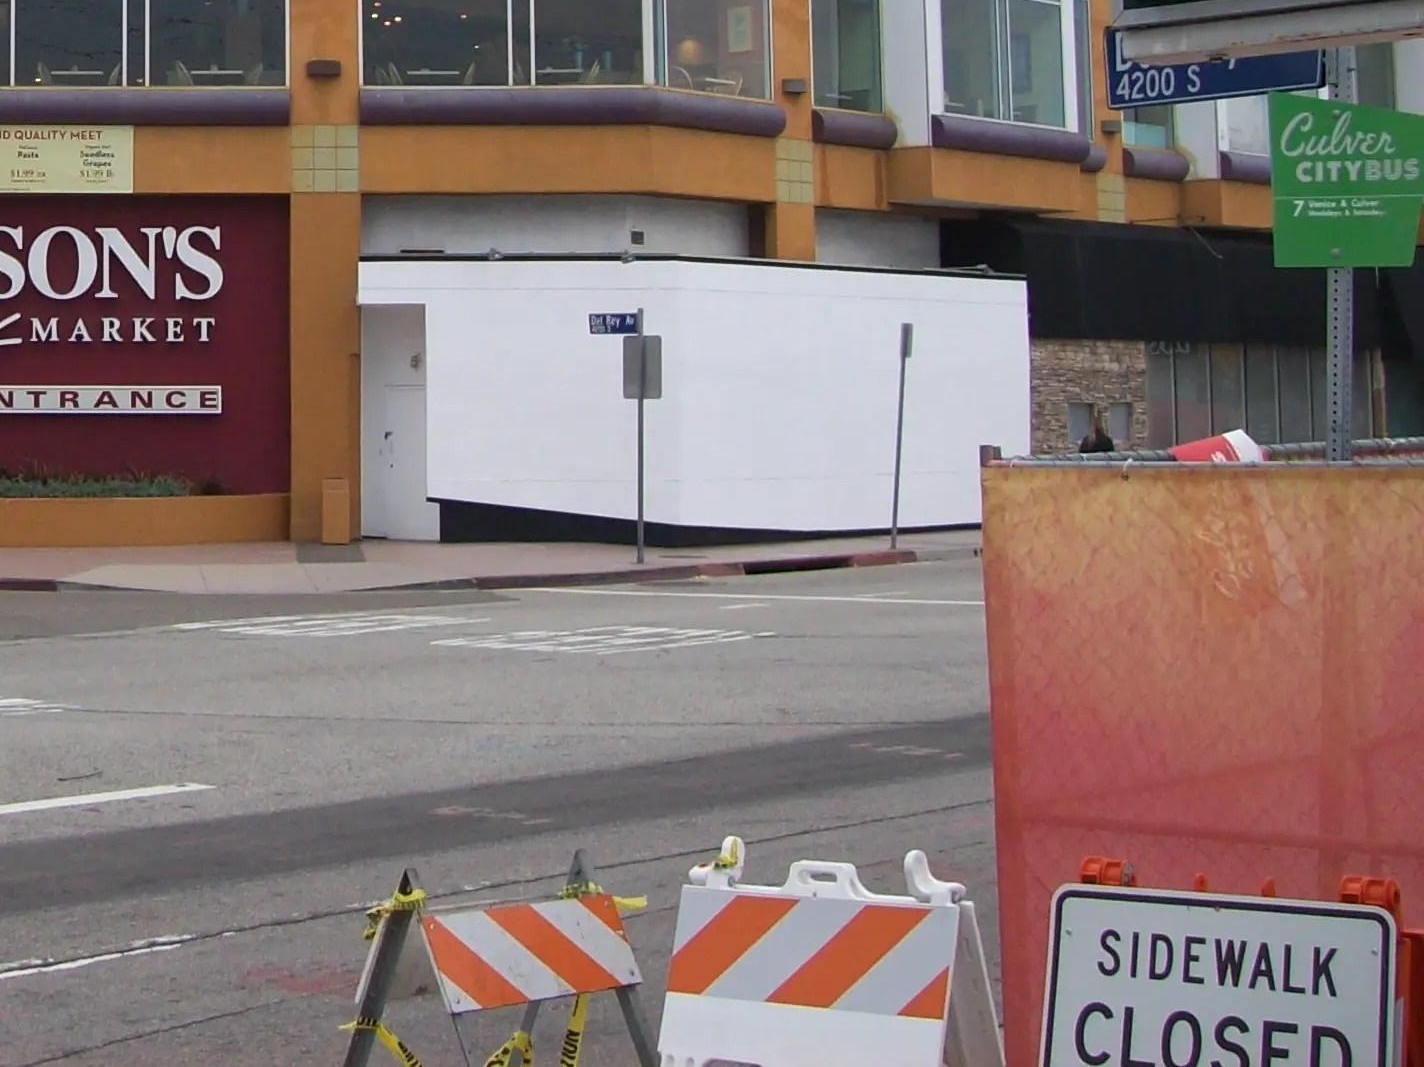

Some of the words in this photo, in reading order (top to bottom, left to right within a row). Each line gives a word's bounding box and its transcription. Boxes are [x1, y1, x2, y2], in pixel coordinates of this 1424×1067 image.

[1116, 67, 1175, 101] 4200
[1187, 64, 1201, 93] S
[14, 130, 68, 141] QUALITY
[70, 130, 103, 141] MEET
[1280, 110, 1396, 157] Culver
[1292, 200, 1305, 217] 7
[29, 316, 217, 343] MARKET
[1096, 928, 1338, 997] SIDEWALK
